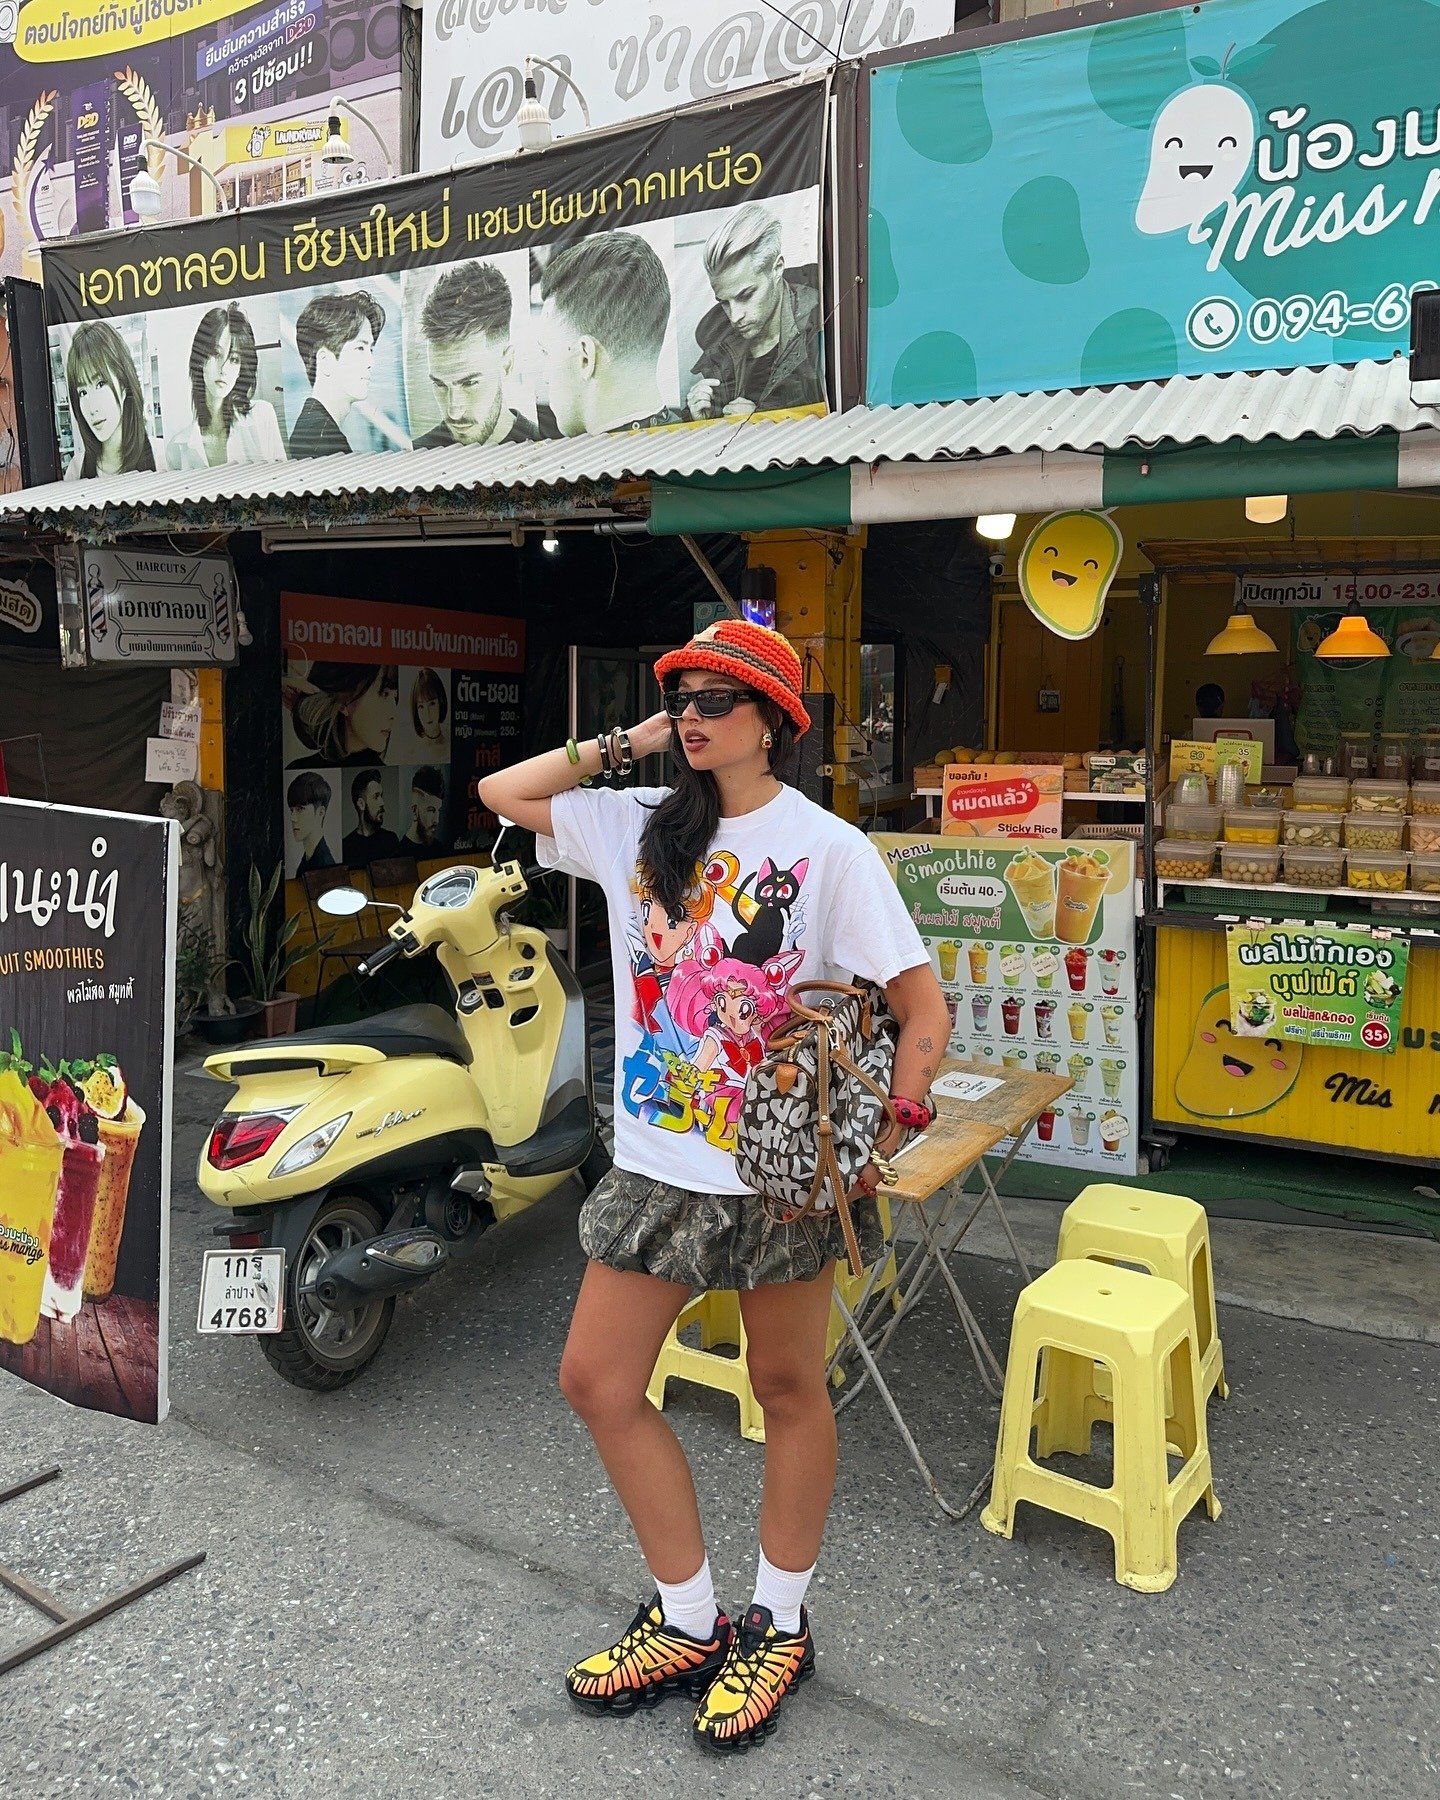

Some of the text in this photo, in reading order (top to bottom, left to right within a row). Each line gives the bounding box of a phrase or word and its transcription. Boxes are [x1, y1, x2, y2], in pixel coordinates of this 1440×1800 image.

[286, 14, 315, 44] DBD
[234, 41, 314, 104] 3 ปีซ้อน!!
[78, 145, 763, 310] เอกซาลอน เชียงใหม่ แชมป์ผมภาคเหนือ
[1188, 184, 1407, 273] Miss
[1247, 282, 1438, 344] 094-6
[136, 560, 187, 575] HAIRCUTS
[1243, 582, 1440, 606] เปิดทุกวัน 15.00-23.
[118, 600, 207, 620] เอกซาลอน
[288, 619, 519, 658] เอกซาลอน แชมป์ผมภาคเหนือ
[456, 674, 519, 704] ตัด-ซอย
[1189, 750, 1204, 761] 50
[1238, 748, 1249, 756] 35
[948, 770, 981, 780] ขออภัย
[952, 787, 1028, 812] หมดแล้ว
[998, 823, 1058, 835] Sticky Rice
[886, 842, 932, 865] Menu
[904, 849, 997, 884] Smoothie
[939, 878, 1004, 897] เริ่มต้น 40.-
[962, 907, 1001, 933] สมูทตี้
[24, 947, 105, 972] SMOOTHIES
[1240, 934, 1394, 969] ผลไม้ตักเอง
[1324, 1072, 1392, 1108] Mis
[225, 1286, 255, 1300] ลำปาง
[210, 1307, 267, 1329] 4768
